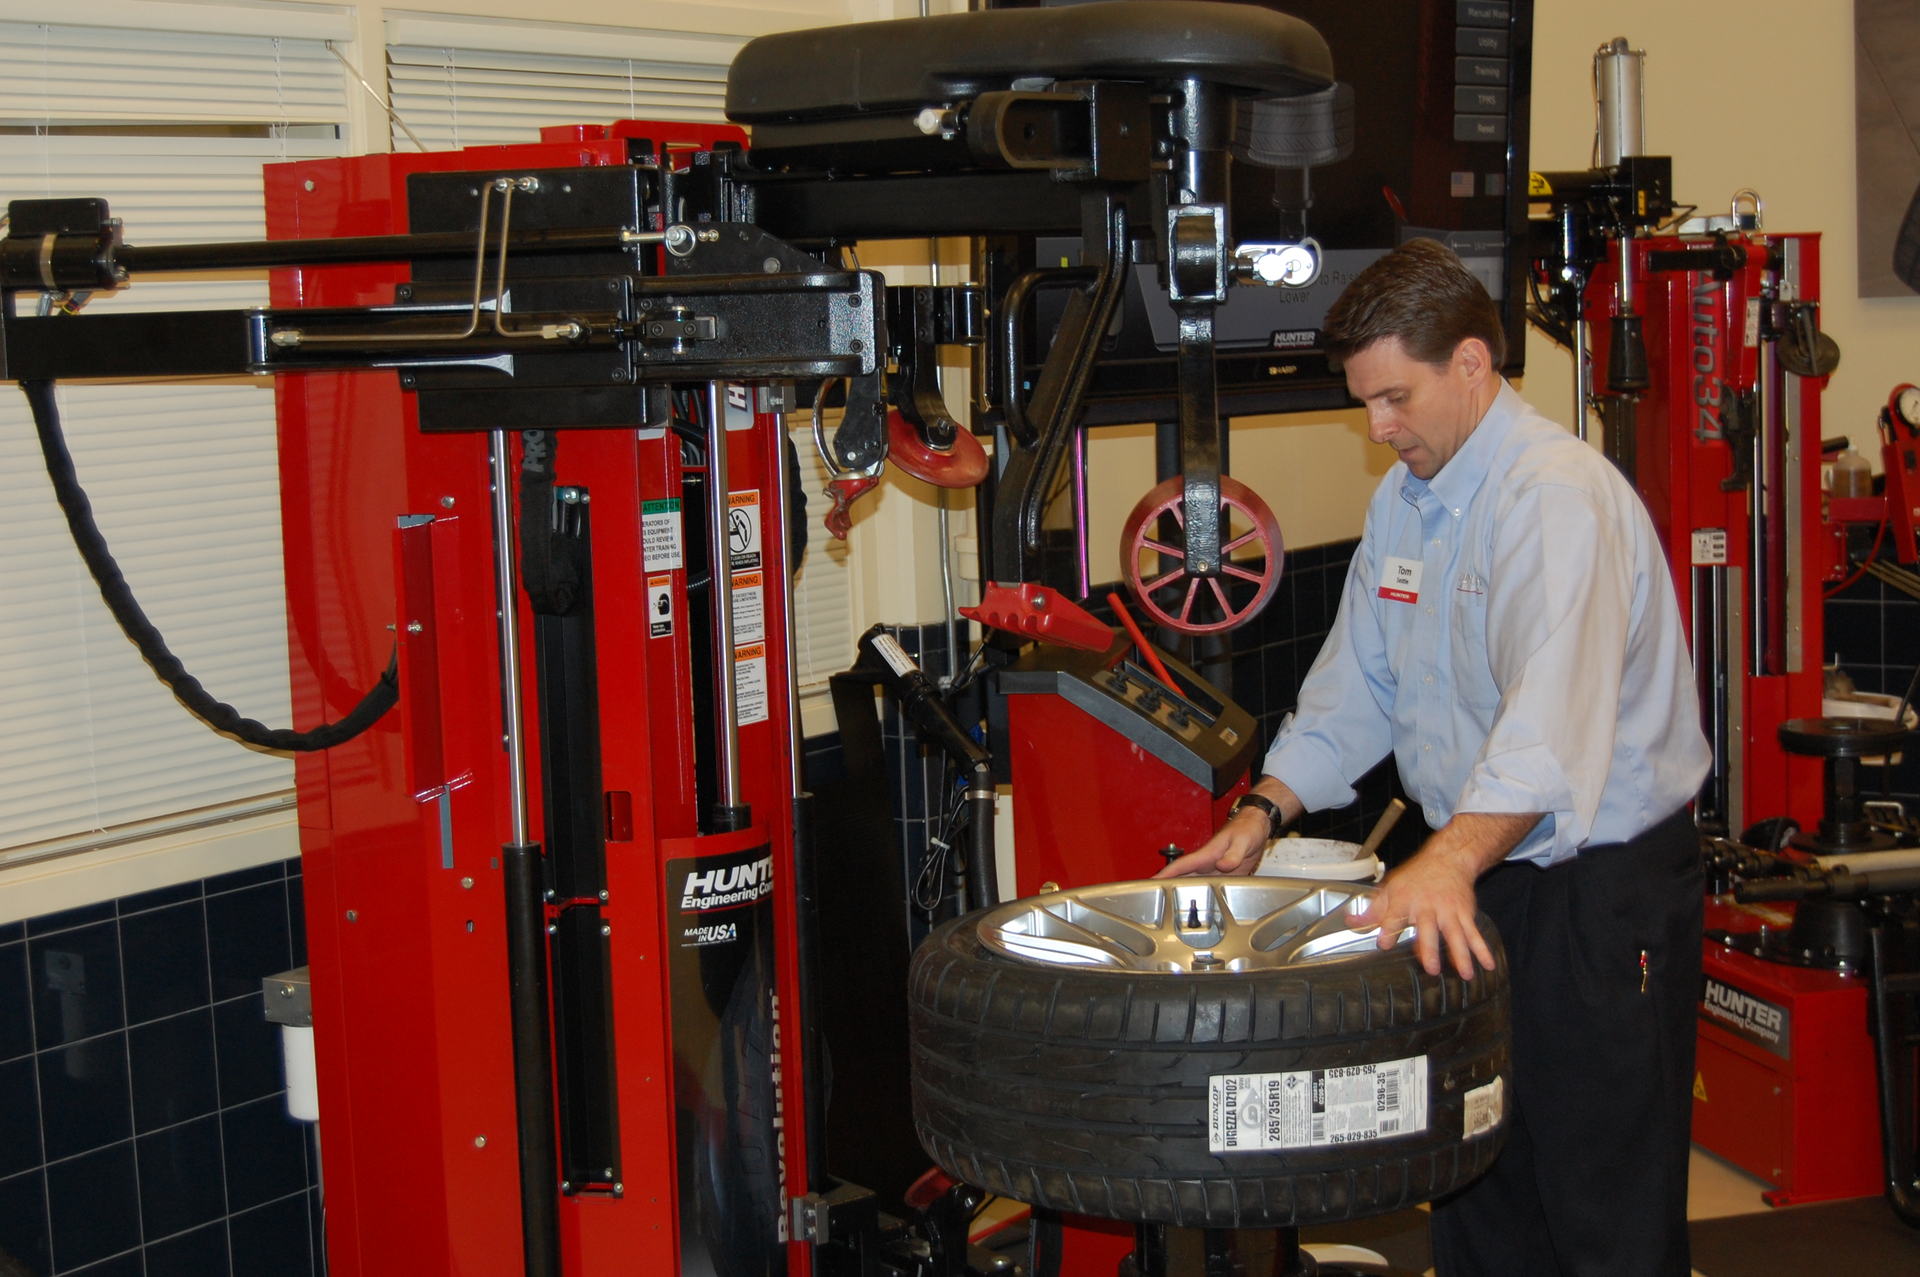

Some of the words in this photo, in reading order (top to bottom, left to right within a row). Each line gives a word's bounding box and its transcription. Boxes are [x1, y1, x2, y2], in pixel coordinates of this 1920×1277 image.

[1475, 65, 1500, 79] Training
[1280, 291, 1311, 303] Lower
[1274, 331, 1315, 343] HUNTER
[1693, 268, 1724, 443] Auto34
[643, 500, 680, 512] ATTENTON
[642, 519, 664, 527] ERATORS
[643, 537, 655, 545] OULD
[656, 543, 677, 552] TRAINNG
[1398, 565, 1412, 576] Tom
[684, 854, 773, 895] HUNTE
[681, 886, 758, 909] Engineering
[684, 926, 709, 936] MADE
[698, 934, 707, 942] IN
[707, 923, 737, 942] USA
[1705, 979, 1782, 1031] HUNTER
[1704, 999, 1744, 1028] Engineering
[1744, 1017, 1780, 1044] Company
[1226, 1078, 1237, 1108] DZ102
[1376, 1072, 1386, 1112] 0298-35
[770, 994, 789, 1243] Revolution
[1268, 1080, 1280, 1142] 285/35R19
[1226, 1109, 1237, 1147] DIREZZA
[1330, 1129, 1378, 1144] 265-029-835
